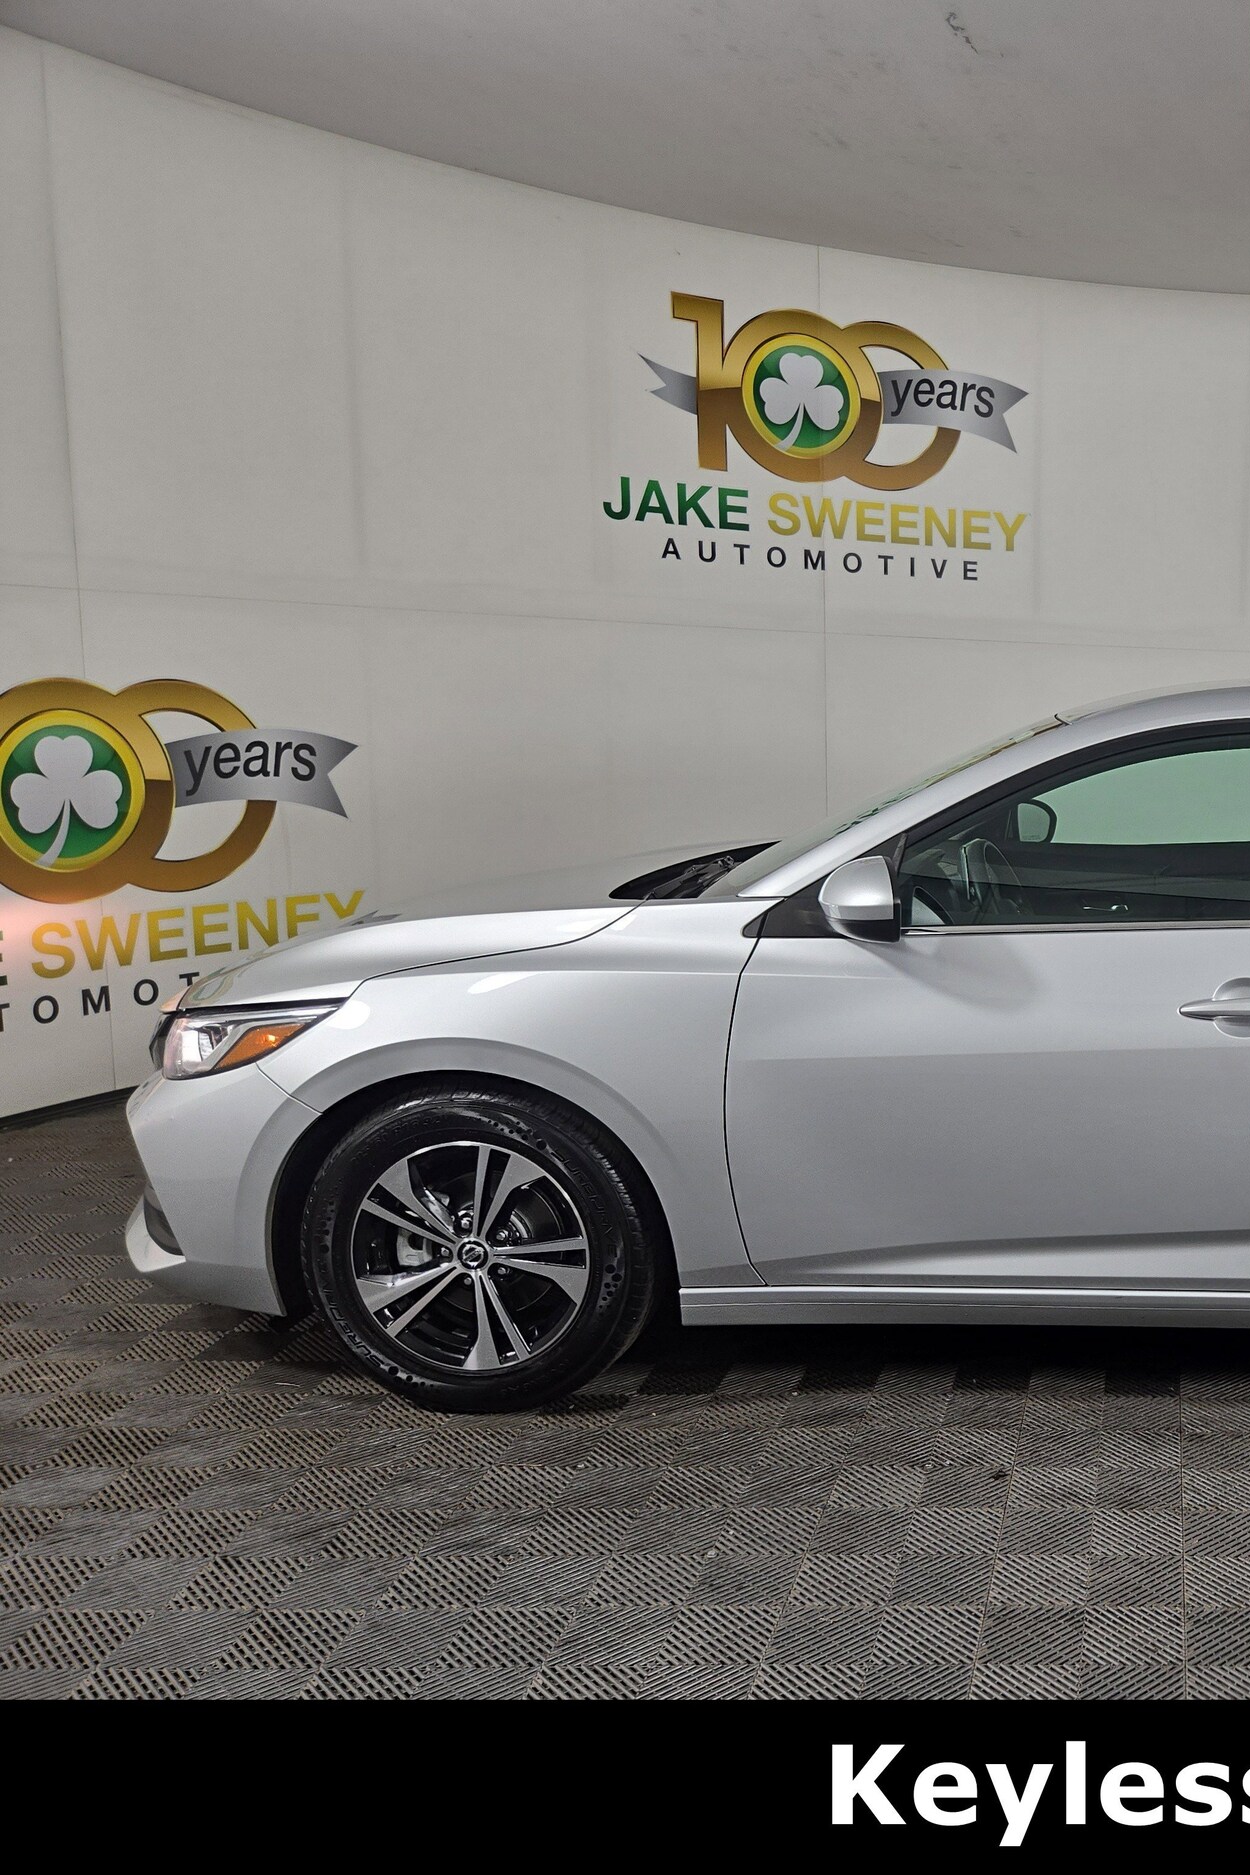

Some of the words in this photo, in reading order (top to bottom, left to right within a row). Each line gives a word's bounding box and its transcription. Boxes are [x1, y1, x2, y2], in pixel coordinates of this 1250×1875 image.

[890, 377, 996, 418] years
[603, 476, 750, 531] JAKE
[768, 493, 1029, 552] SWEENEY
[661, 537, 979, 581] AUTOMOTIVE
[184, 740, 317, 797] years
